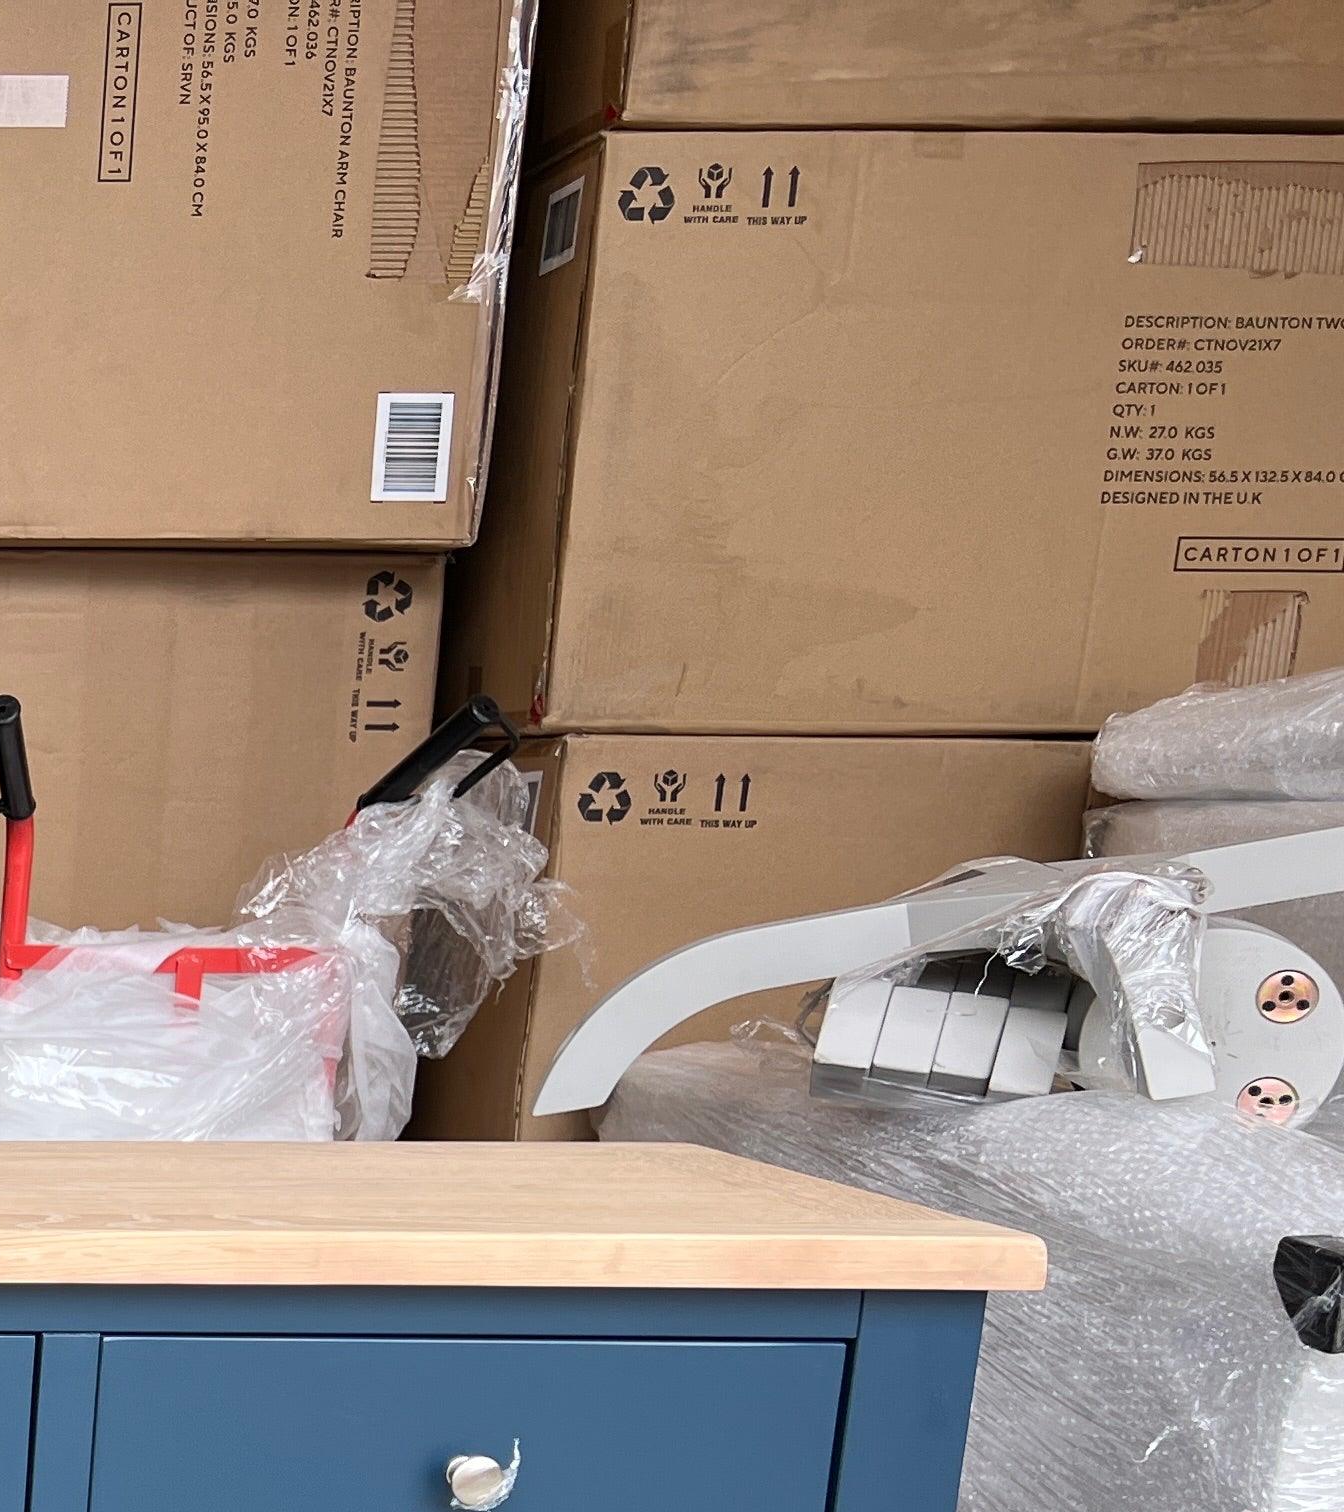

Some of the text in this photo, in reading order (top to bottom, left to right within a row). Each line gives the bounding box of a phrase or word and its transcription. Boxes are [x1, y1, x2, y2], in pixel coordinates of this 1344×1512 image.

[182, 34, 195, 59] OF:
[223, 32, 236, 63] KGS
[244, 27, 257, 57] KGS
[286, 35, 297, 58] OF
[112, 12, 131, 108] CARTON
[322, 26, 338, 116] CTNOV21X7
[179, 63, 193, 105] SRVN
[200, 61, 213, 91] 56.5
[199, 94, 211, 104] X
[340, 68, 356, 146] BAUNTON
[196, 108, 210, 139] 95.0
[109, 131, 124, 161] OF
[196, 142, 208, 152] X
[193, 156, 207, 187] 84.0
[335, 150, 349, 184] ARM
[191, 192, 204, 217] CM
[332, 190, 346, 238] CHAIR
[747, 216, 807, 225] THIS WAY UP
[1124, 315, 1231, 329] DESCRIPTION:
[1235, 316, 1312, 330] BAUNTON
[1122, 338, 1281, 351] ORDER#: CTNOV21X7
[1118, 360, 1223, 373] SKU#: 462.035
[1116, 382, 1226, 395] CARTON: 1 OF 1
[1112, 404, 1155, 418] QTY: 1
[1185, 426, 1215, 439] KGS
[1182, 449, 1212, 461] KGS
[1103, 470, 1205, 483] DIMENSIONS:
[1209, 470, 1238, 483] 56.5
[1241, 471, 1251, 482] X
[1255, 470, 1288, 483] 132.5
[1291, 471, 1302, 482] X
[1304, 470, 1335, 483] 84.0
[1100, 491, 1262, 505] DESIGNED IN THE U.K
[1184, 547, 1339, 563] CARTON 1 OF 1
[358, 632, 366, 654] WITH
[366, 639, 375, 674] HANDLE
[349, 689, 360, 742] THIS WAY UP
[700, 820, 757, 828] THIS WAY UP
